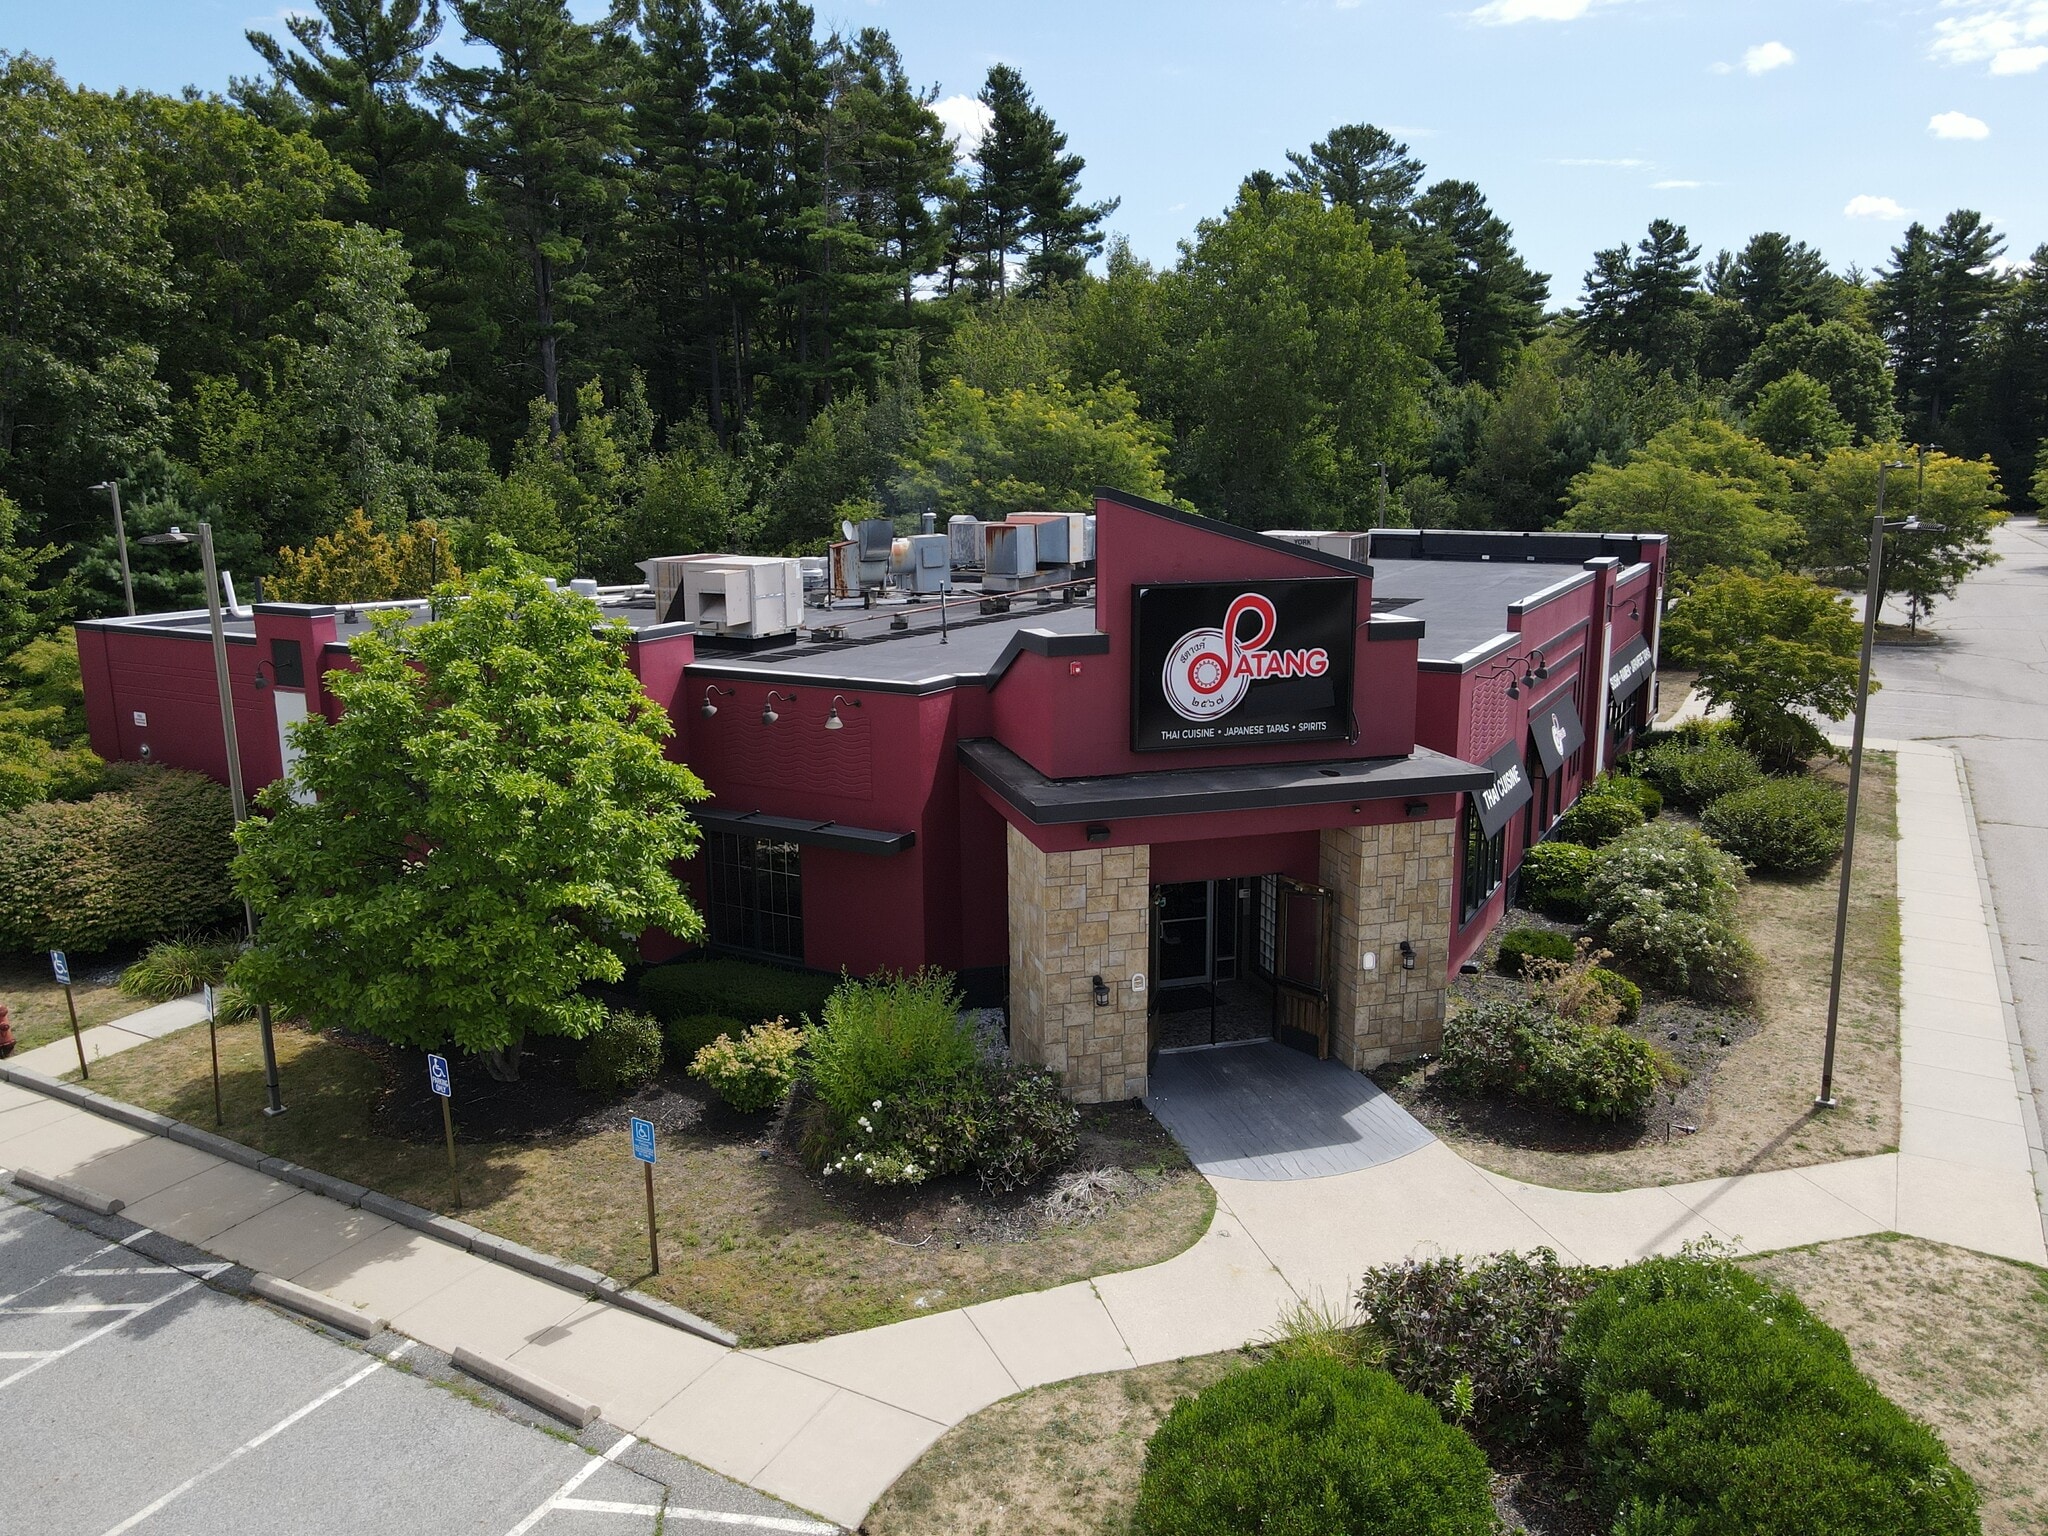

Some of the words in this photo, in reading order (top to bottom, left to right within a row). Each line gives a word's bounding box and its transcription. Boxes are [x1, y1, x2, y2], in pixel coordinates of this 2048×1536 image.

[1161, 730, 1180, 740] THAI
[1181, 728, 1215, 739] CUISINE
[1224, 725, 1265, 737] JAPANESE
[1266, 723, 1290, 734] TAPAS
[1298, 721, 1327, 732] SPIRITS
[1482, 783, 1501, 810] THAI
[1496, 764, 1521, 797] CUISINE
